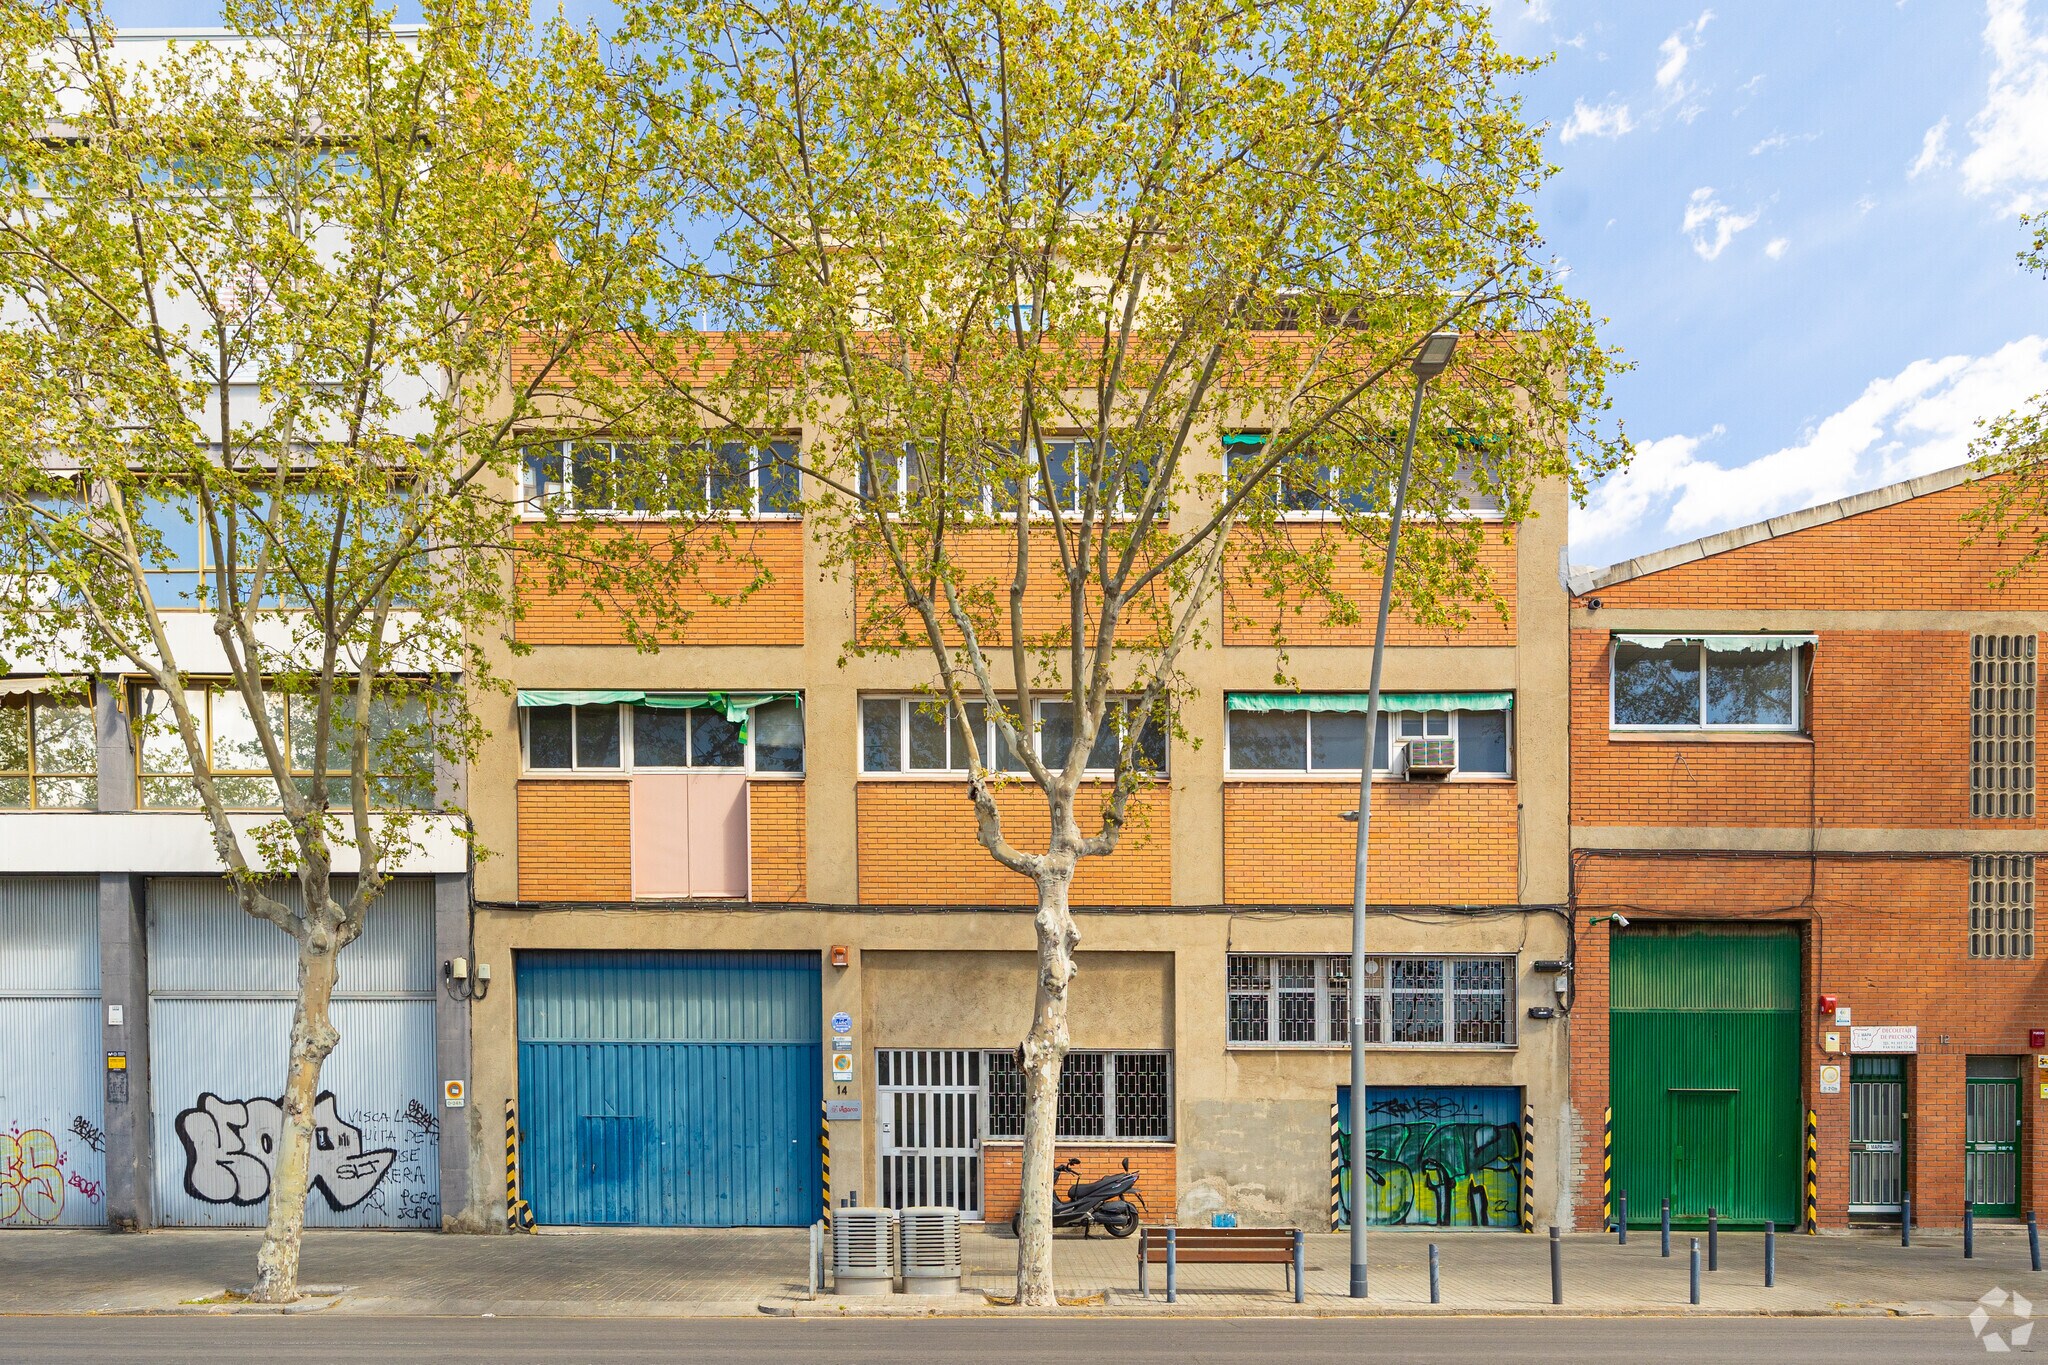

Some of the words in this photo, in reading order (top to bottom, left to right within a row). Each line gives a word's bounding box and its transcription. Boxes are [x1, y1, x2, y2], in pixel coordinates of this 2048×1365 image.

[1940, 1034, 1950, 1044] 12
[837, 1085, 848, 1095] 14
[348, 1108, 390, 1123] VISCA
